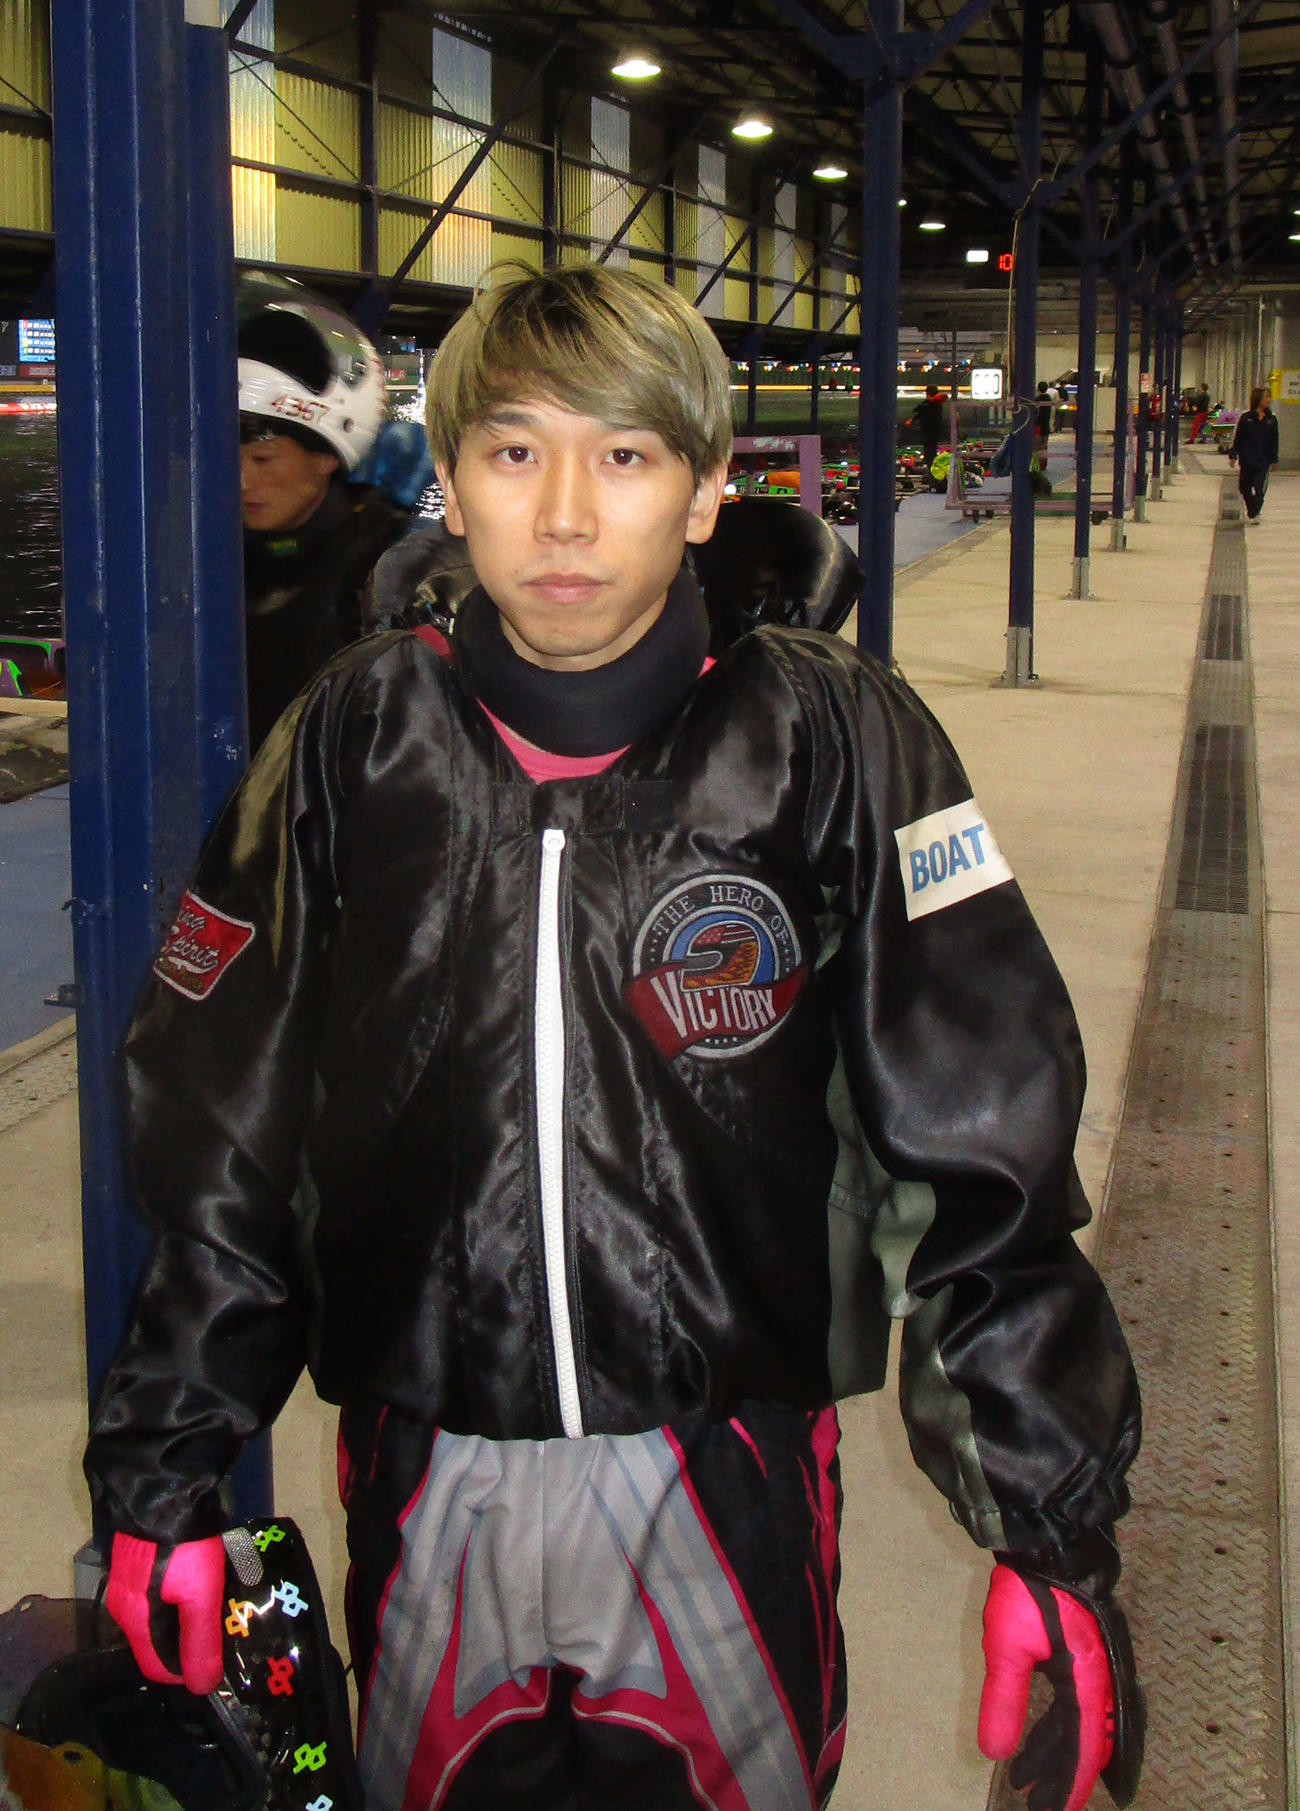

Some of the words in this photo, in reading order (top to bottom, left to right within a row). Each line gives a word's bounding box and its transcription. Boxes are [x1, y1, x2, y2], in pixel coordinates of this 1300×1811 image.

[909, 822, 985, 893] BOAT
[652, 895, 696, 933] THE
[709, 885, 764, 912] HERO
[770, 914, 791, 945] OF
[650, 970, 777, 1038] VICTORY
